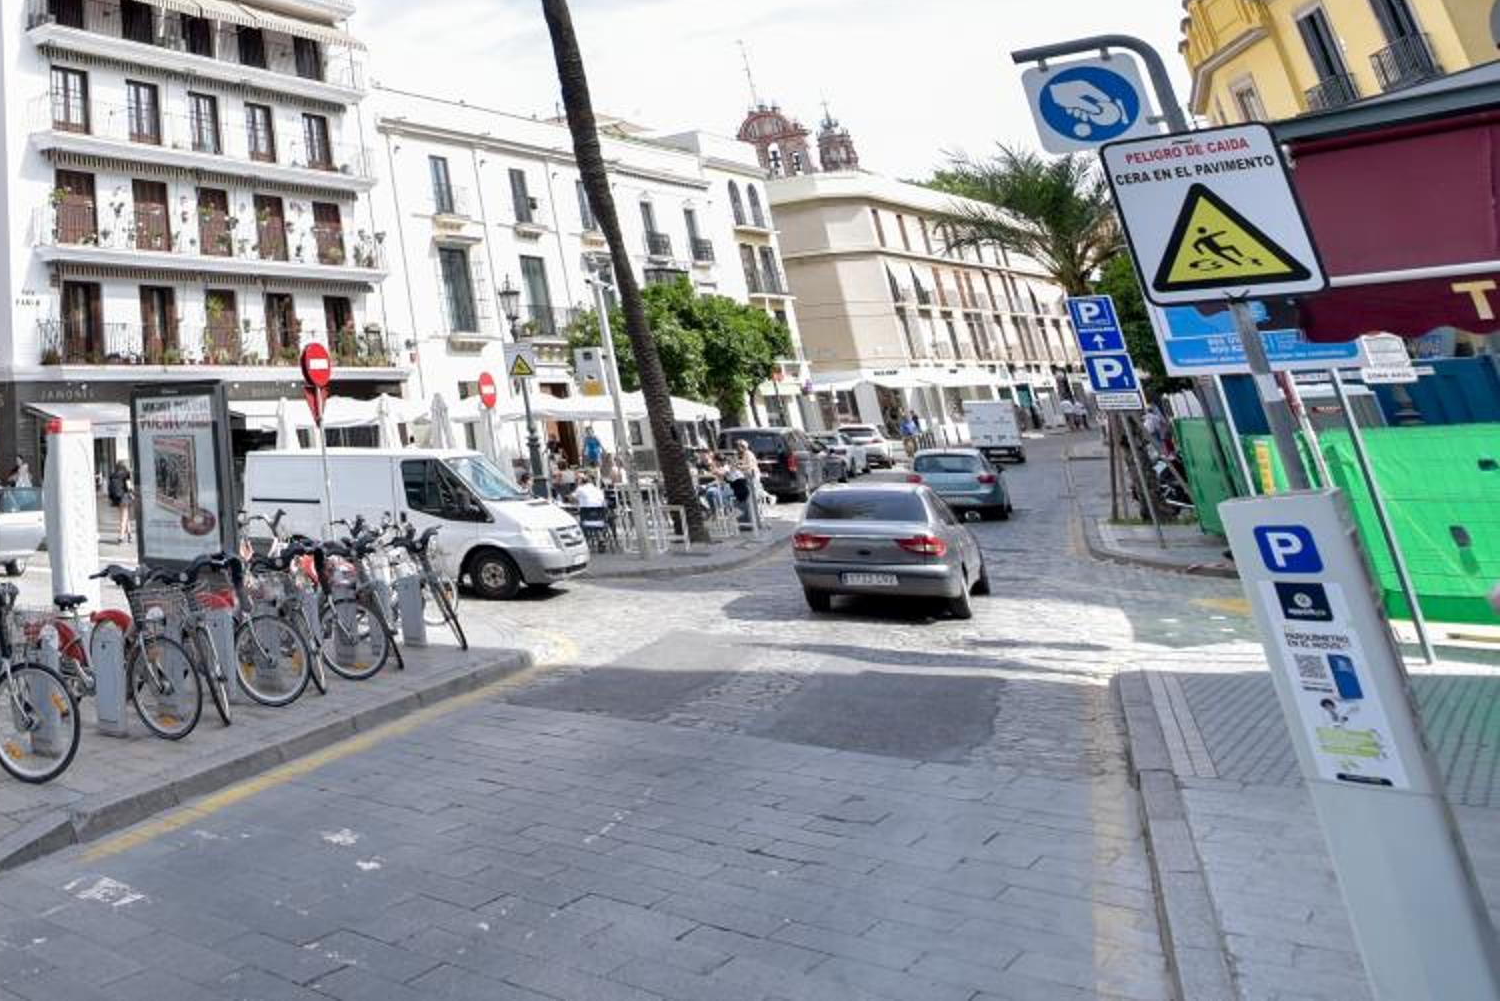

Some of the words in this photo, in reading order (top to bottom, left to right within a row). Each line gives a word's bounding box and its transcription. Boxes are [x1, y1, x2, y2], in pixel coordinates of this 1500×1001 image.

[1125, 148, 1181, 164] PELIGRO
[1187, 143, 1203, 157] DE
[1115, 171, 1151, 186] CERA
[1153, 170, 1172, 181] EN
[1175, 165, 1193, 178] EL
[1195, 154, 1275, 176] PAVIMENTO
[1265, 532, 1303, 567] P
